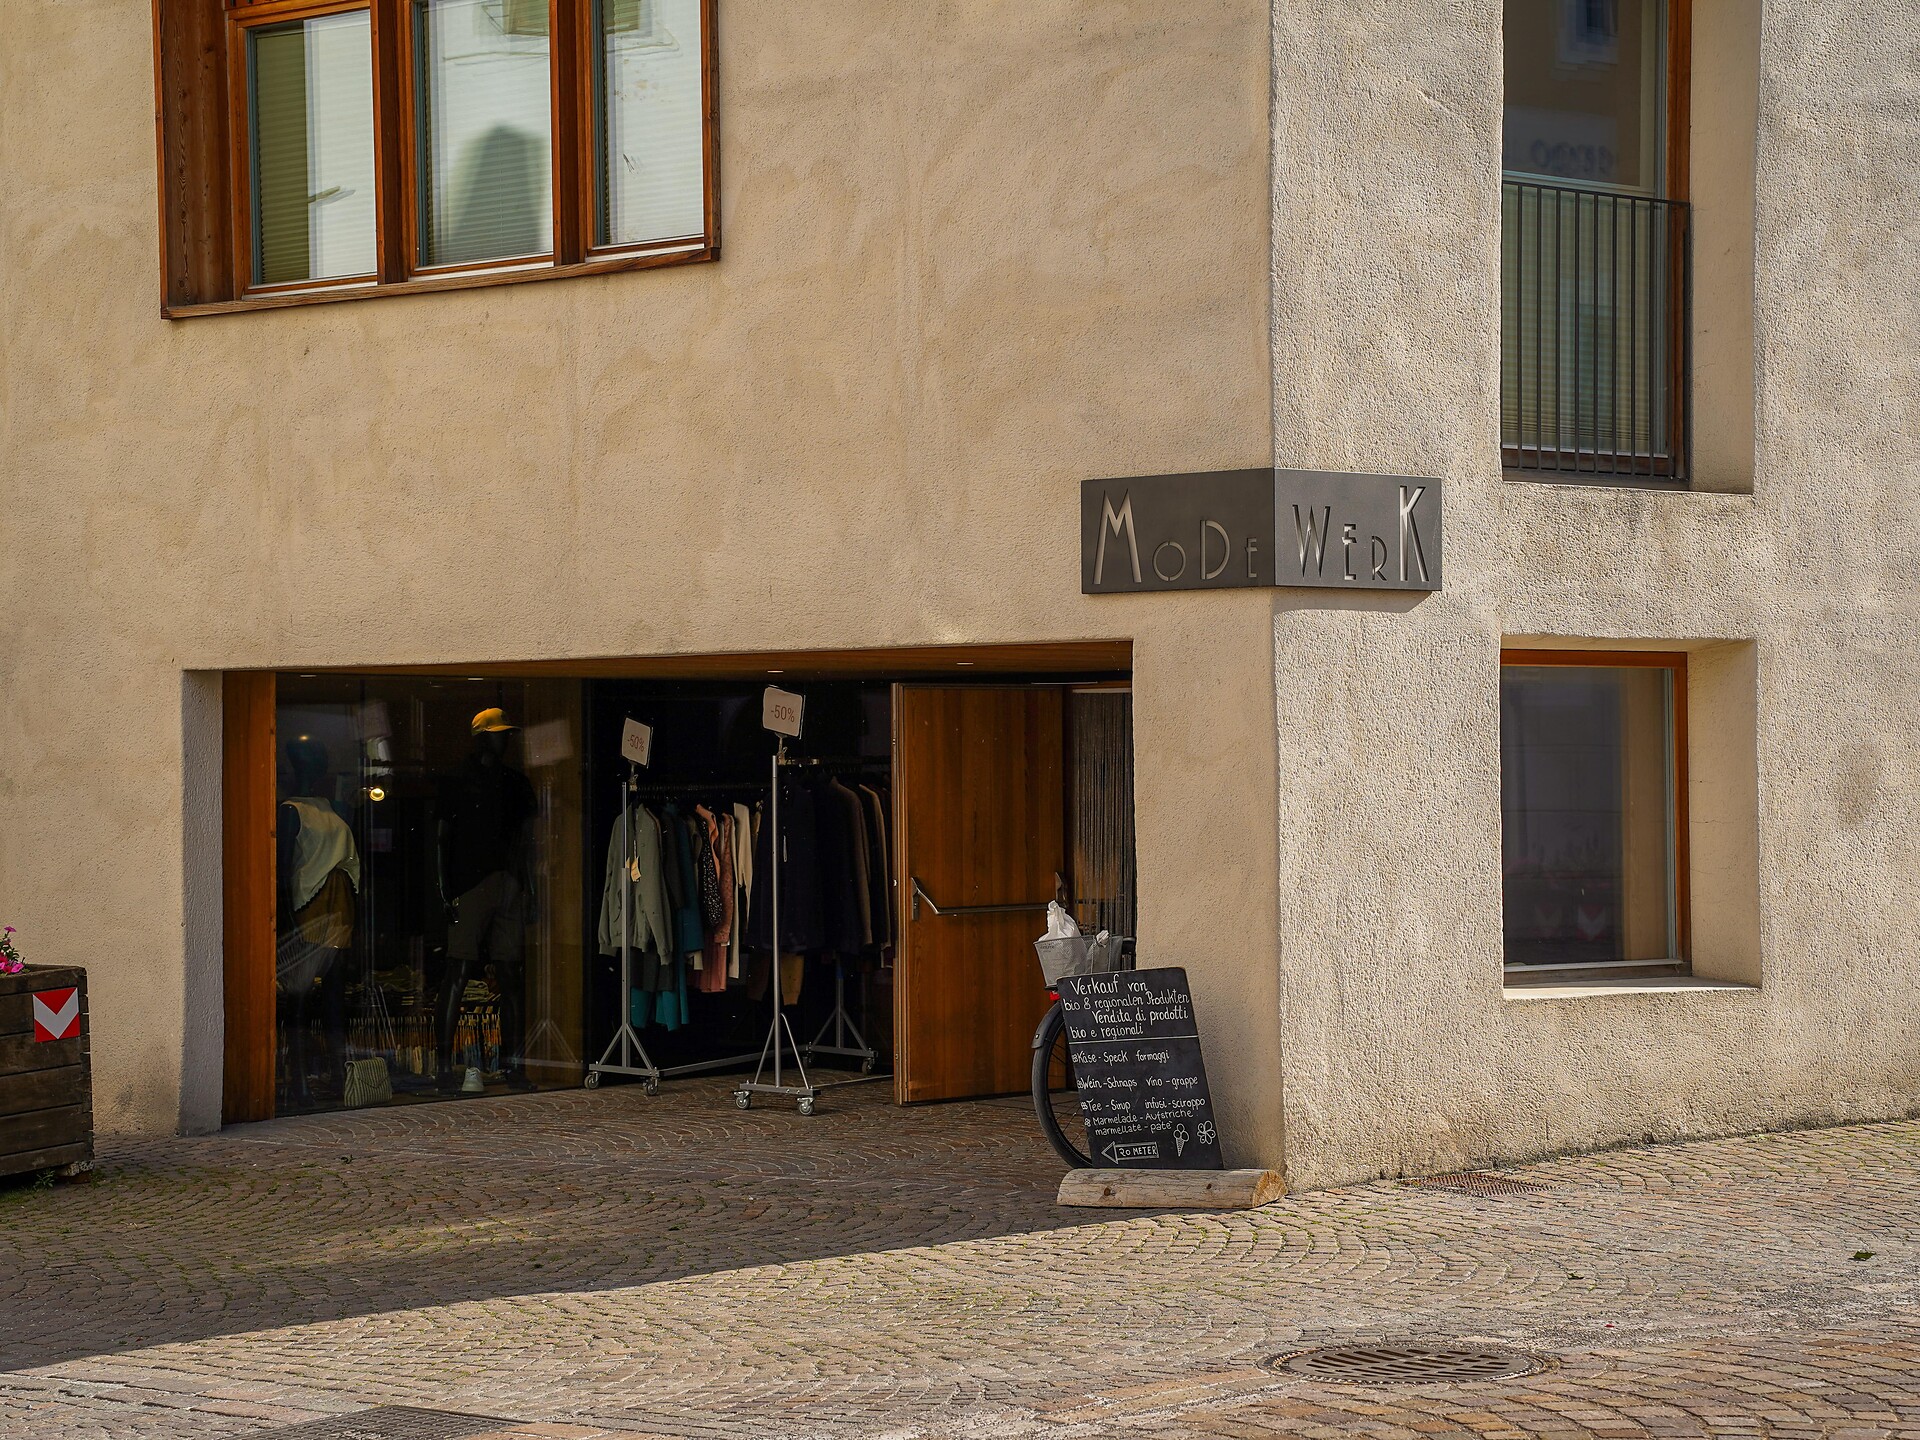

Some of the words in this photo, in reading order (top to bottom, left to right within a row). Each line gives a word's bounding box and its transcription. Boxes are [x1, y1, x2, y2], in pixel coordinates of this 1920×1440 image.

[770, 704, 795, 723] -50%
[627, 734, 645, 752] -50%
[1070, 974, 1119, 995] Verkauf
[1128, 981, 1148, 992] von
[1063, 998, 1081, 1011] bio
[1094, 994, 1143, 1012] regionalen
[1146, 989, 1190, 1005] Produkten
[1092, 1008, 1132, 1024] Vendita
[1135, 1007, 1147, 1021] di
[1149, 1006, 1189, 1025] prodotti
[1070, 1027, 1086, 1039] bio
[1091, 1030, 1098, 1038] e
[1100, 1023, 1144, 1040] regionali
[1136, 1049, 1170, 1064] formaggi
[1082, 1075, 1102, 1089] Wein
[1146, 1075, 1163, 1087] vino
[1171, 1075, 1198, 1090] grappe
[1087, 1099, 1103, 1112] Tee
[1092, 1113, 1137, 1126] Marmelade
[1145, 1109, 1194, 1123] Aufstriche
[1095, 1123, 1142, 1136] marmellate
[1119, 1147, 1131, 1158] 20
[1133, 1145, 1158, 1156] METER
